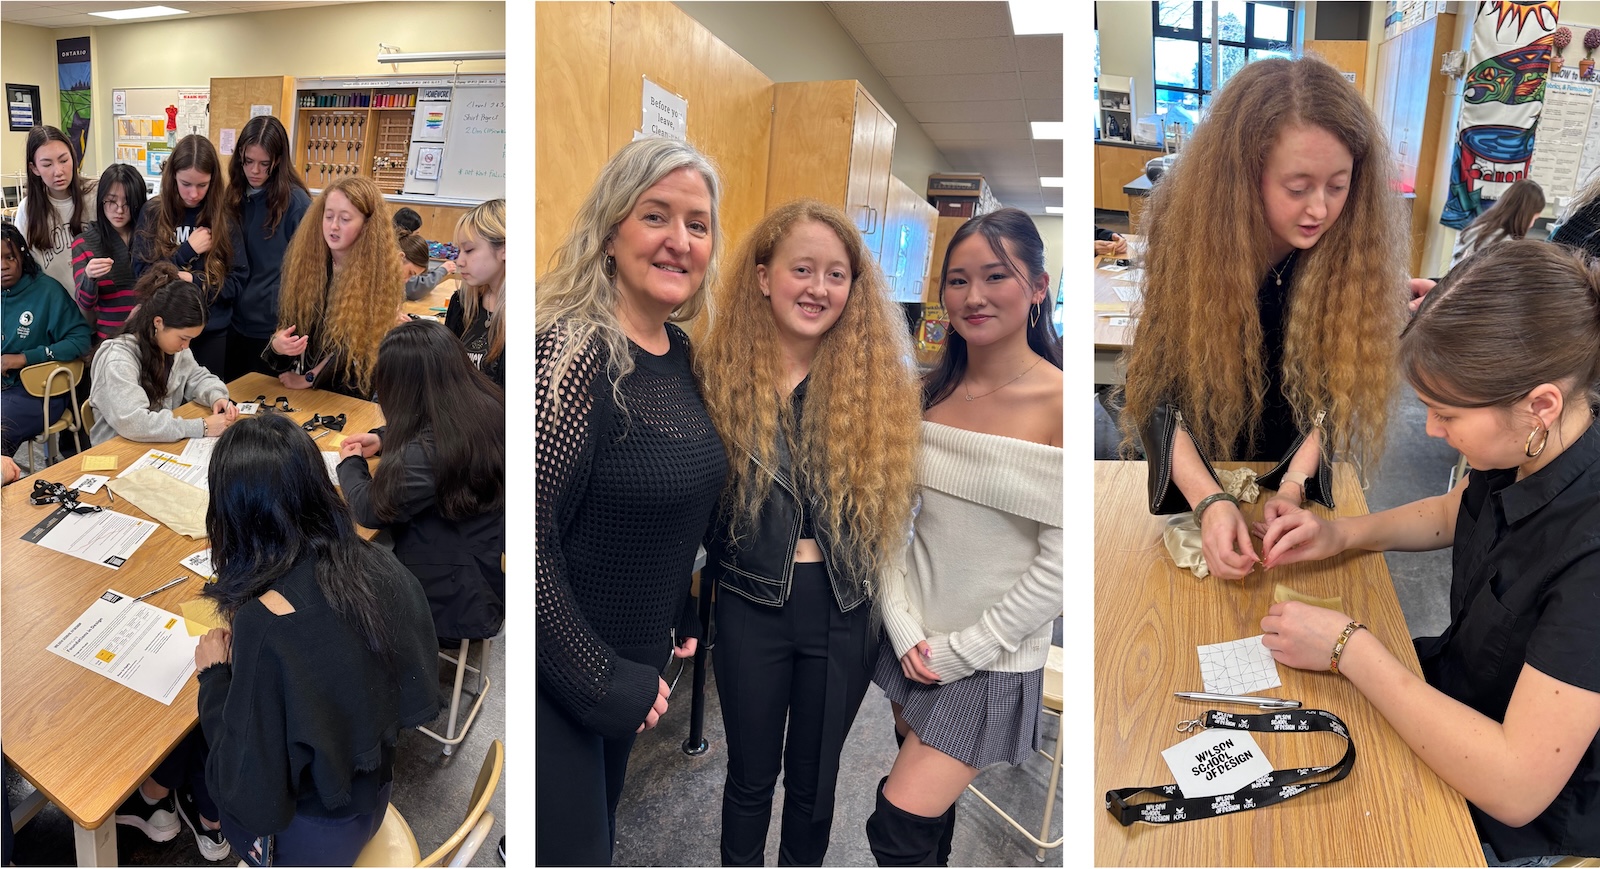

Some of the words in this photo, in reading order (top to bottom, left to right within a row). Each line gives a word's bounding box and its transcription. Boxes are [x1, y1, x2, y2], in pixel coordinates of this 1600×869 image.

[61, 49, 87, 58] ONTARIO
[1572, 71, 1579, 80] to
[425, 90, 449, 99] HOMEWORK
[650, 96, 671, 114] Before
[657, 112, 675, 131] leave,
[65, 631, 89, 652] Foundations
[89, 617, 104, 629] Design
[1195, 738, 1234, 763] WILSON
[1191, 752, 1233, 776] SCHOOL
[1206, 767, 1217, 781] OF
[1217, 750, 1254, 775] DESIGN
[1173, 813, 1187, 821] KPU
